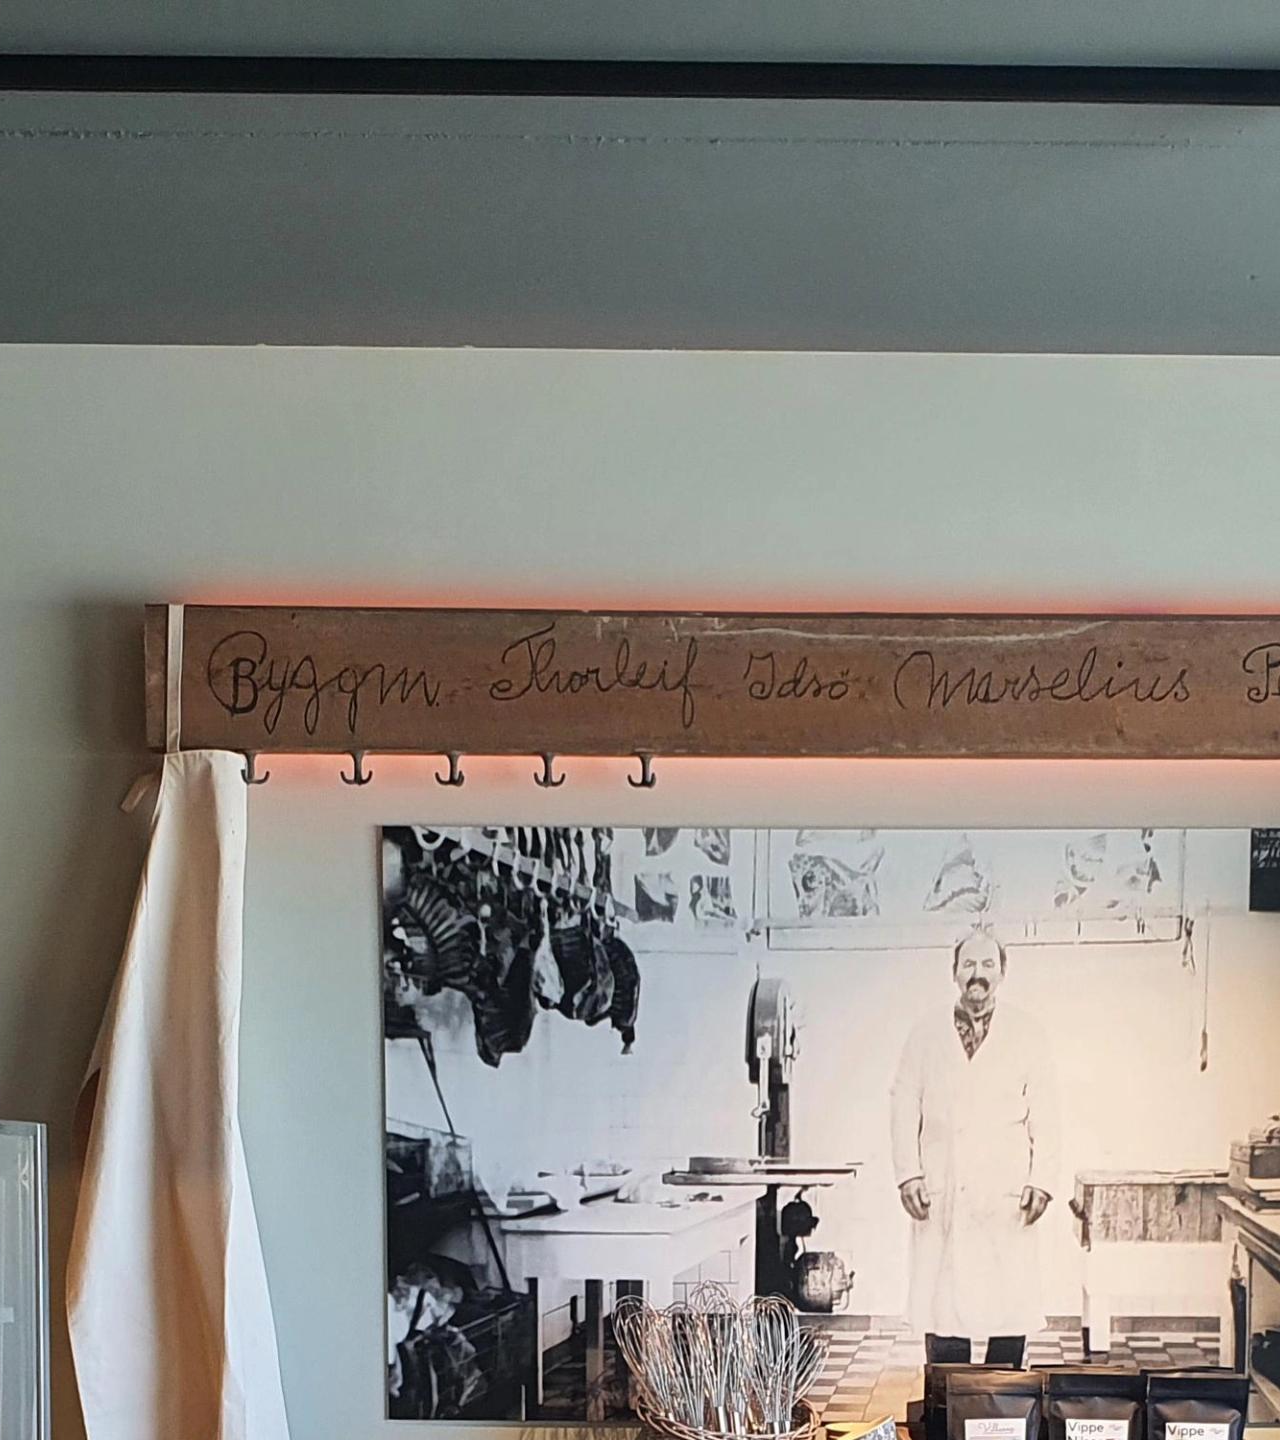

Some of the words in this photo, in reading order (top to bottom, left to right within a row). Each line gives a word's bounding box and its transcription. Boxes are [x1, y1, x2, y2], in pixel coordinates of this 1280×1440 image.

[489, 622, 697, 729] Thorleif
[1067, 1421, 1105, 1434] Vippe
[1167, 1425, 1205, 1438] Vippe
